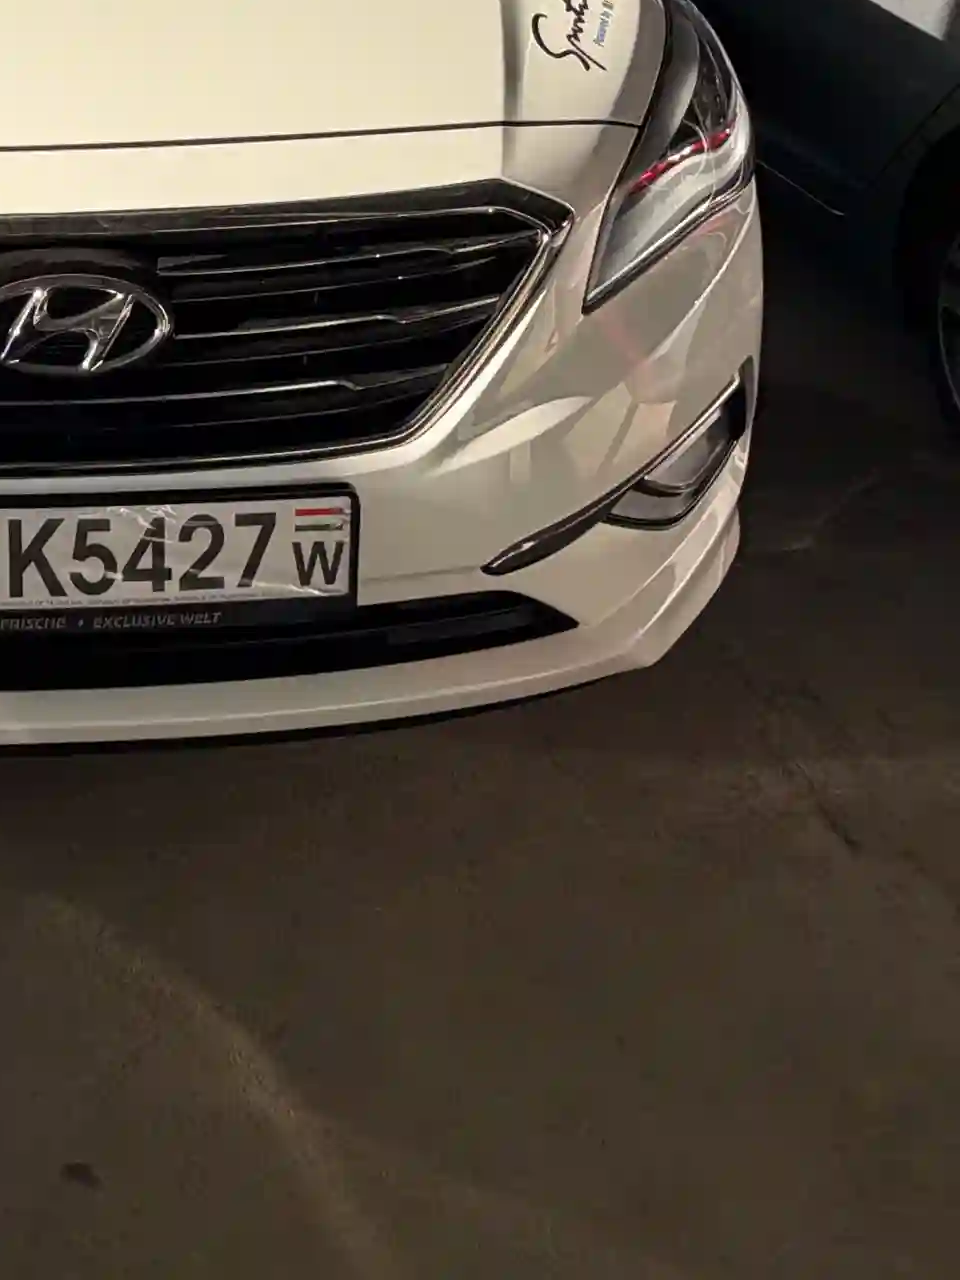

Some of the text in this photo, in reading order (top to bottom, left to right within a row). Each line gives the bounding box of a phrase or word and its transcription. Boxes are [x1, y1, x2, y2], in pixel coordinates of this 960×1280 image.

[8, 512, 278, 598] K5427
[292, 540, 344, 587] W
[93, 614, 176, 629] EXCLUSIVE
[180, 611, 222, 625] WELT
